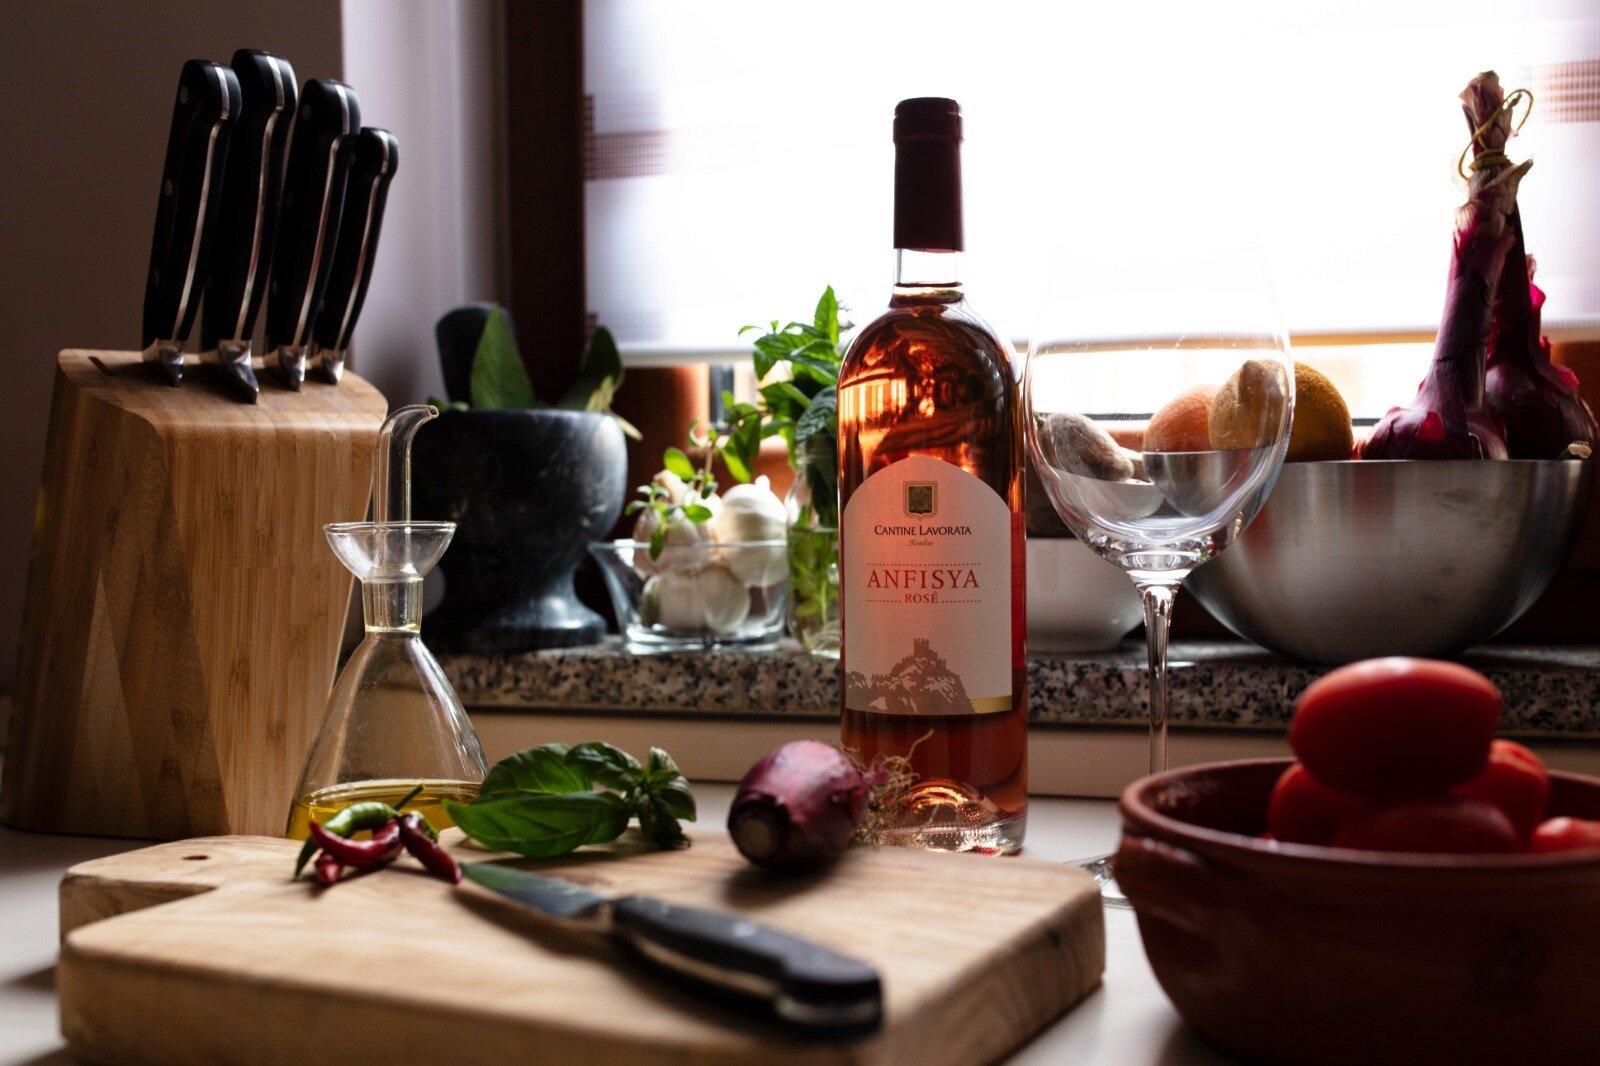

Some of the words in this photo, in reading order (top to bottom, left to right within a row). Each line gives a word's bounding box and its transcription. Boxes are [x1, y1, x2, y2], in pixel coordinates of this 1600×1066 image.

[874, 525, 916, 536] CANTINE
[919, 525, 972, 536] LAVORATA
[866, 569, 980, 589] ANFISYA
[904, 591, 938, 604] ROSÉ
